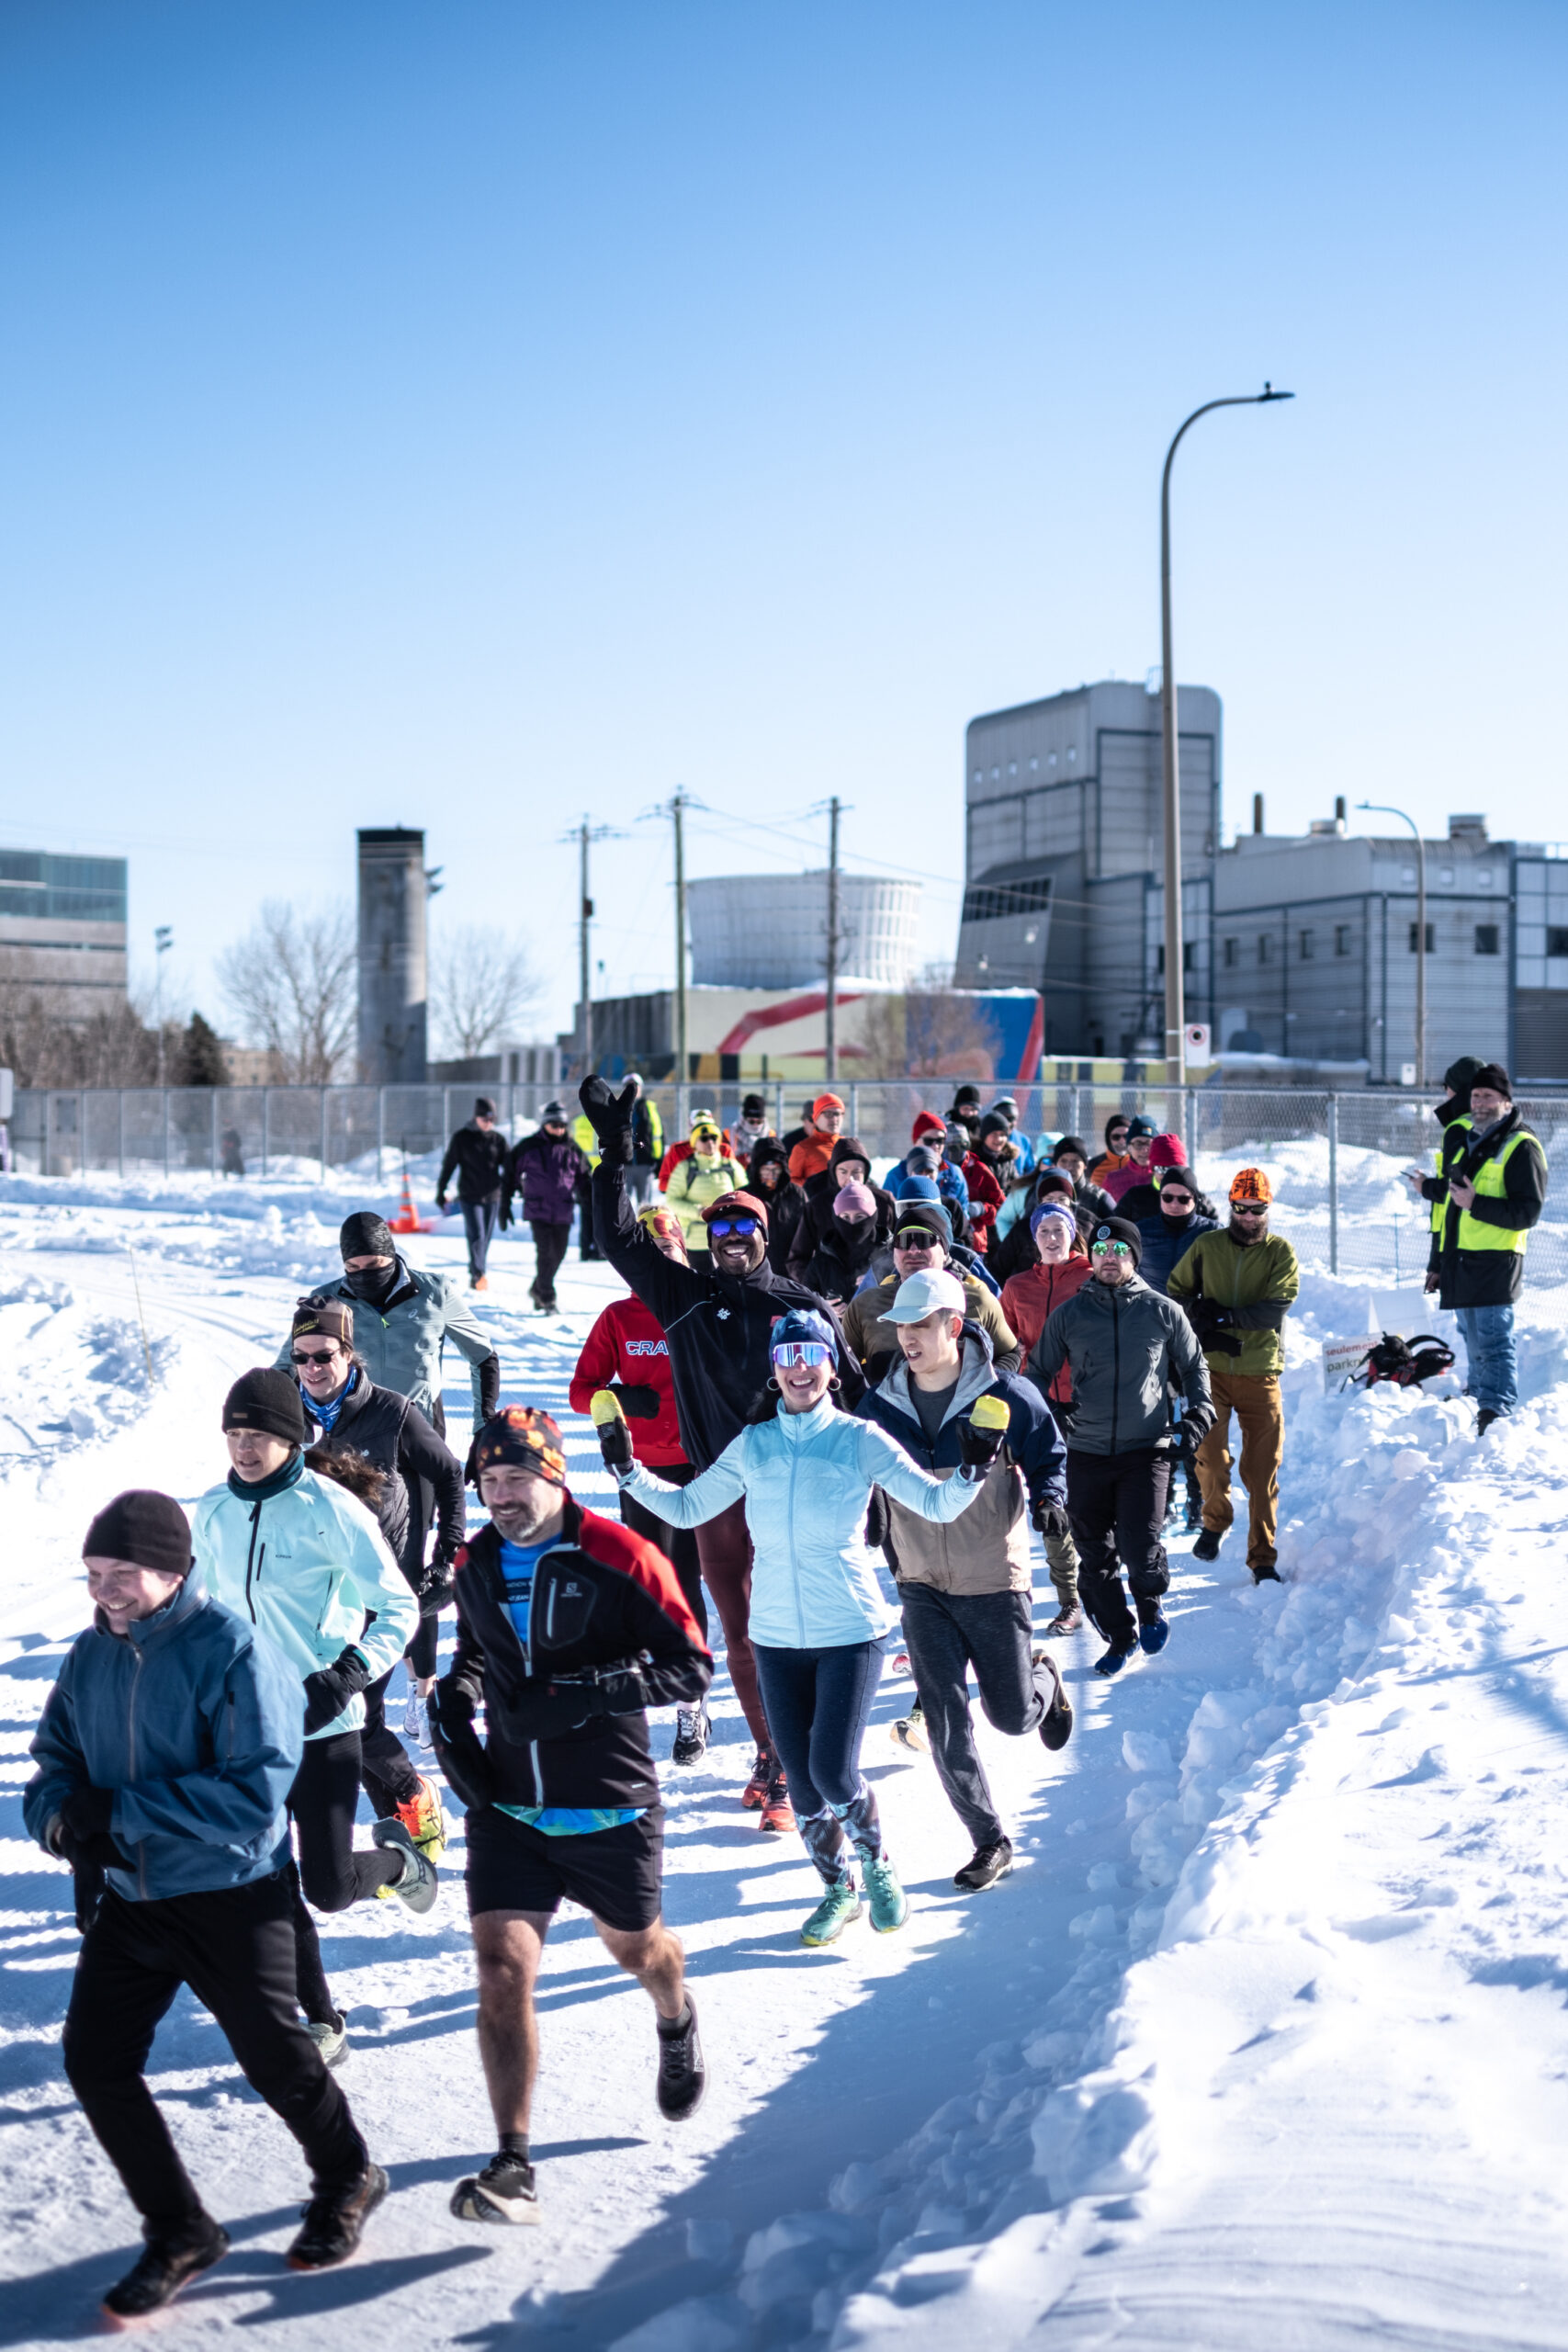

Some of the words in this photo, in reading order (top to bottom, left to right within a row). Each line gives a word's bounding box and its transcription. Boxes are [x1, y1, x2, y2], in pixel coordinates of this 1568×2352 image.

[626, 1340, 669, 1356] CRA
[1325, 1340, 1378, 1357] seulement
[1326, 1358, 1369, 1374] parkr
